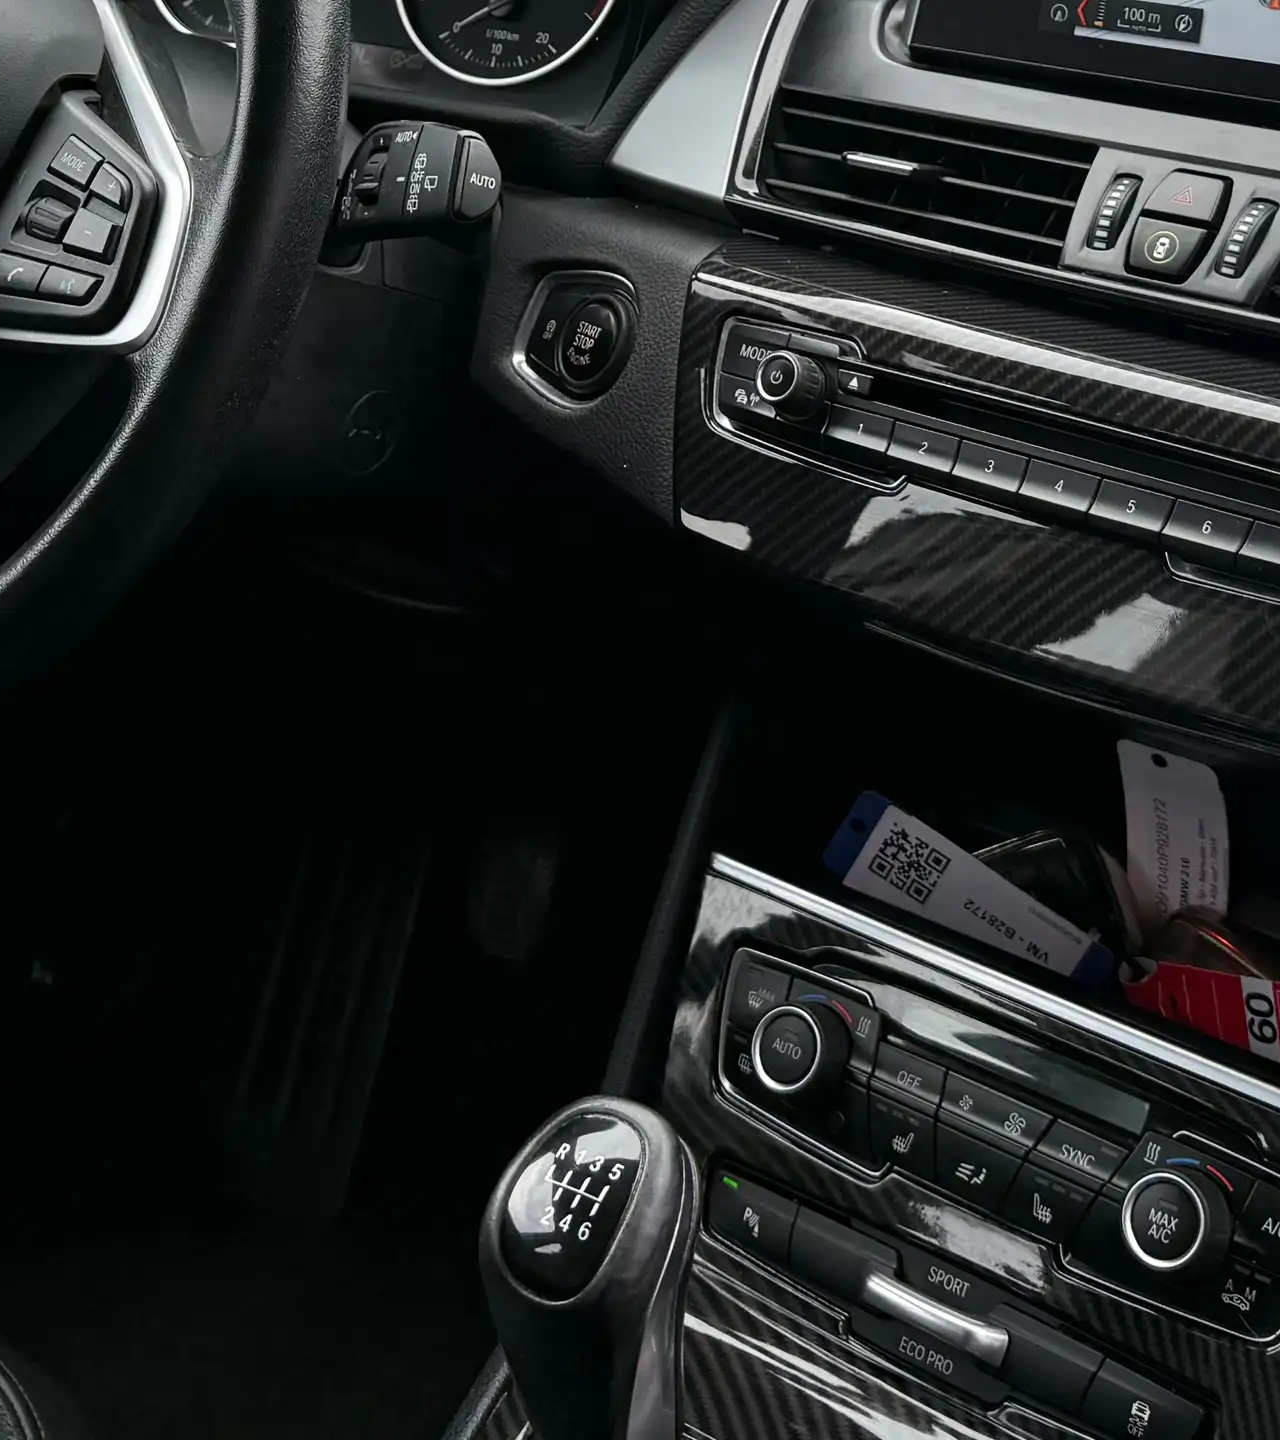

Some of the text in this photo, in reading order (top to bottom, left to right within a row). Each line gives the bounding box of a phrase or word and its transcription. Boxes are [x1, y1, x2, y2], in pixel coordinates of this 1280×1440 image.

[1123, 7, 1160, 24] 100 m
[535, 32, 550, 44] 20
[491, 43, 503, 55] 10
[394, 130, 412, 143] AUTO
[60, 151, 87, 172] MODE
[410, 171, 424, 182] OFF
[470, 172, 496, 189] AUTO
[409, 183, 420, 194] ON
[577, 320, 602, 339] START
[572, 333, 595, 350] STOP
[857, 423, 864, 435] 1
[918, 441, 929, 455] 2
[984, 459, 995, 473] 3
[1053, 478, 1064, 493] 4
[1126, 499, 1136, 515] 5
[1202, 520, 1213, 535] 6
[963, 897, 1017, 940] B28172
[1245, 992, 1277, 1044] 60
[772, 1037, 802, 1060] AUTO
[896, 1070, 923, 1089] OFF
[555, 1142, 625, 1181] R 1 3 5
[1059, 1144, 1096, 1170] SYNC
[540, 1206, 592, 1241] 2 4 6
[1148, 1207, 1179, 1232] MAX
[1147, 1225, 1172, 1244] A/C
[927, 1265, 971, 1298] SPORT
[1224, 1279, 1257, 1303] A M
[898, 1336, 954, 1375] ECO PRO
[1127, 1423, 1145, 1438] OFF
